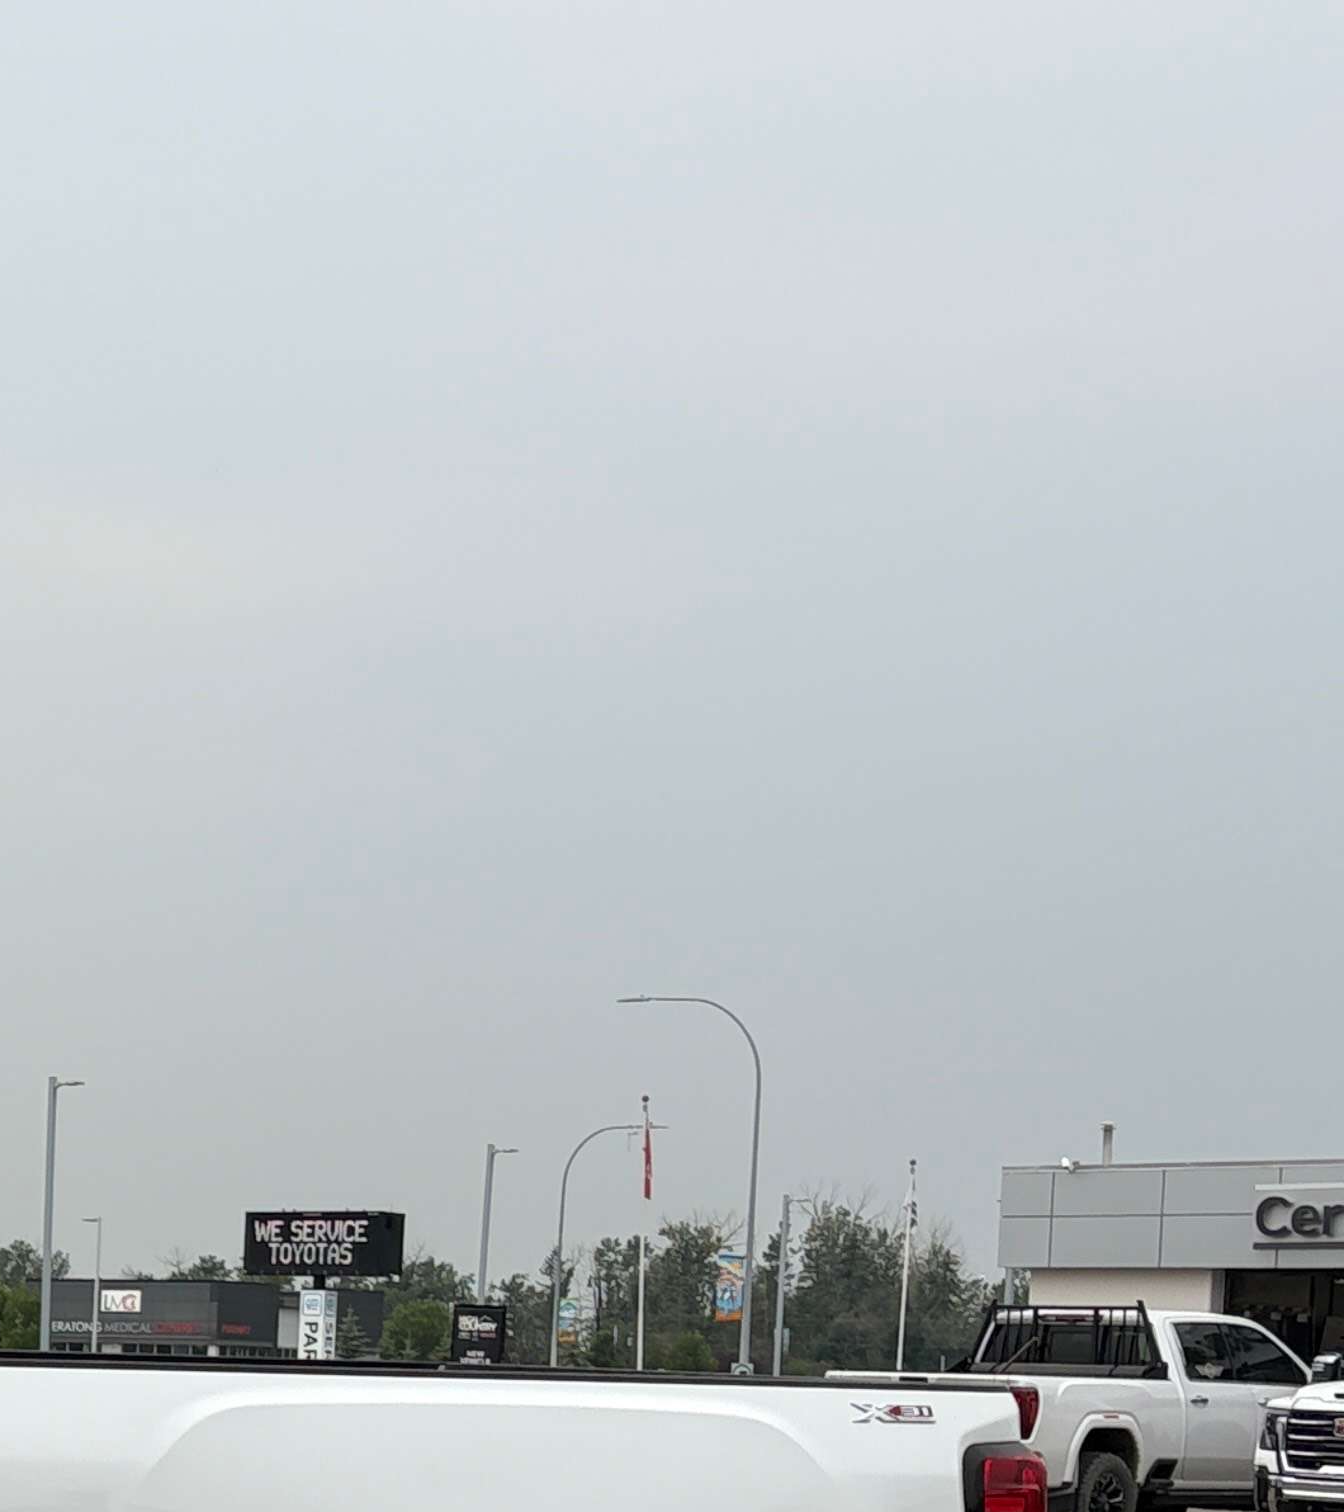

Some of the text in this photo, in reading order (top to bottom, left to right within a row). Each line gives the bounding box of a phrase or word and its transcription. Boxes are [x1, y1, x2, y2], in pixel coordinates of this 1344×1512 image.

[254, 1220, 368, 1242] WE SERVICE
[268, 1243, 353, 1265] TOYOTAS
[104, 1323, 152, 1334] MEDICAL
